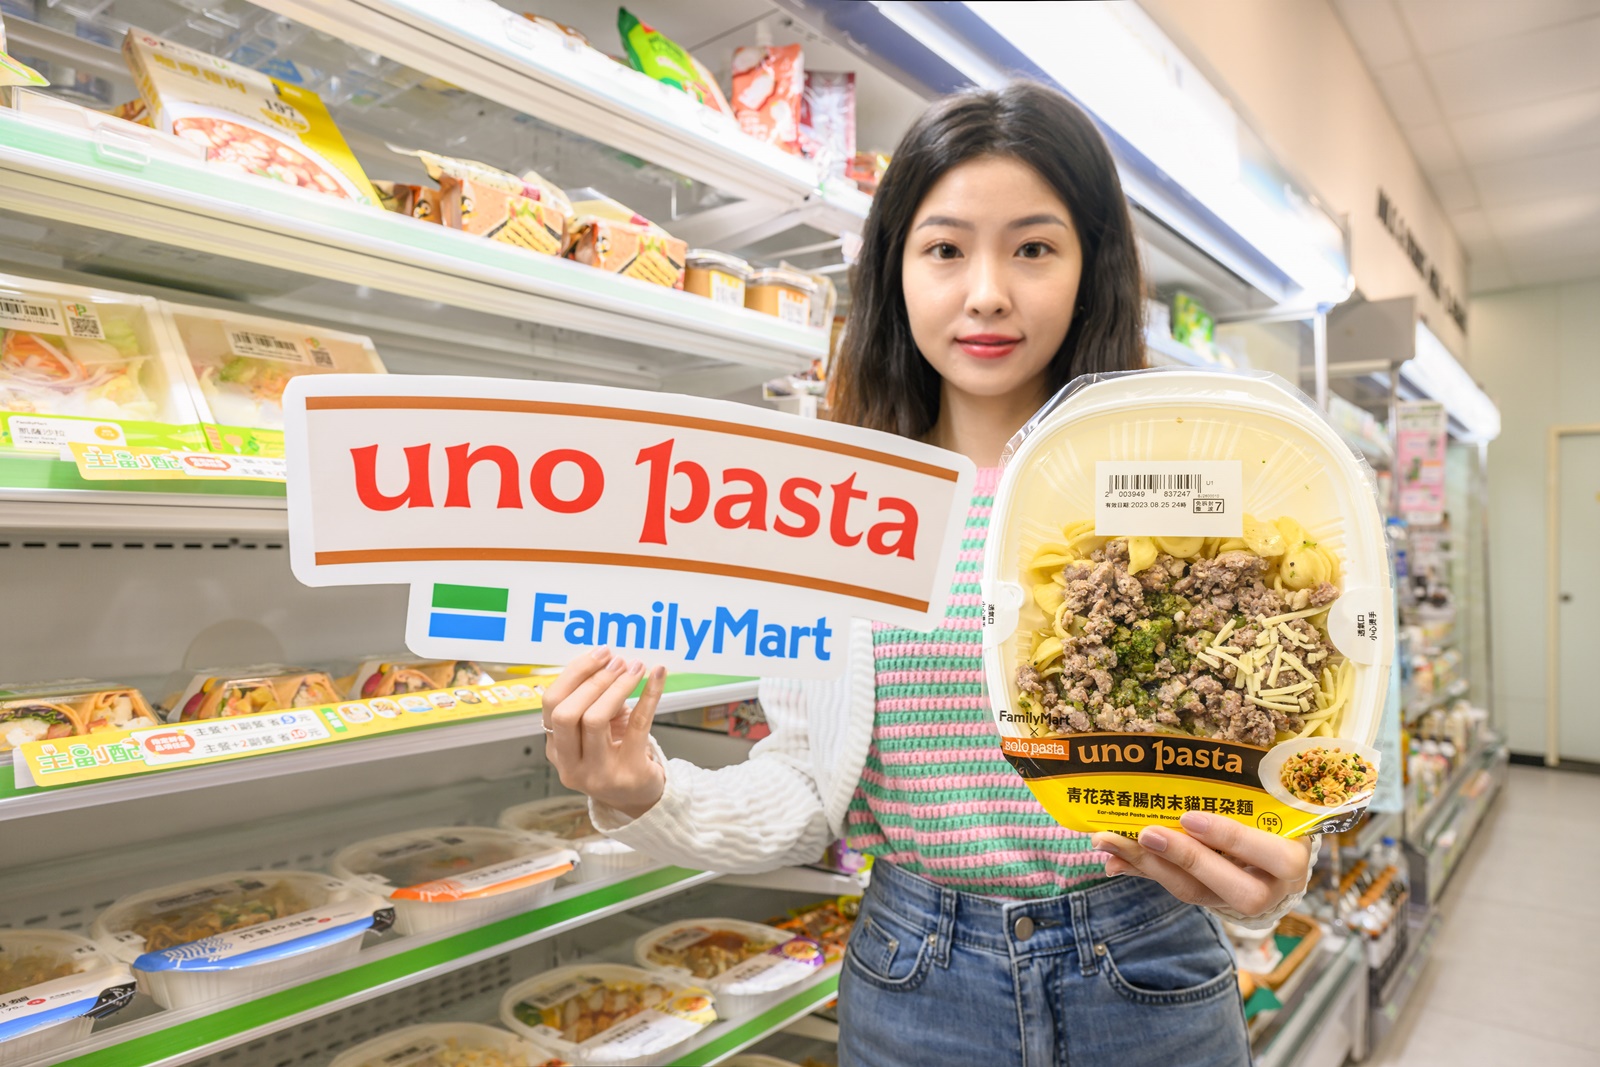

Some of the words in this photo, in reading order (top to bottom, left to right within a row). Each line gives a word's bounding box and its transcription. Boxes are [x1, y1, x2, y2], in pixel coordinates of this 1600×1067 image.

[349, 442, 606, 514] uno
[635, 437, 920, 562] pasta
[1118, 490, 1146, 498] 003949
[1163, 490, 1191, 498] 837247
[1214, 501, 1222, 511] 7
[531, 593, 833, 662] FamilyMart
[998, 710, 1071, 726] FamilyMart
[1004, 738, 1029, 753] solo
[1030, 742, 1065, 756] pasta
[1077, 743, 1145, 765] uno
[1152, 738, 1243, 774] pasta
[1066, 787, 1254, 816] 青花菜香腸肉末貓耳朵麵
[1097, 809, 1129, 817] Ear-shaped
[1262, 817, 1278, 827] 155
